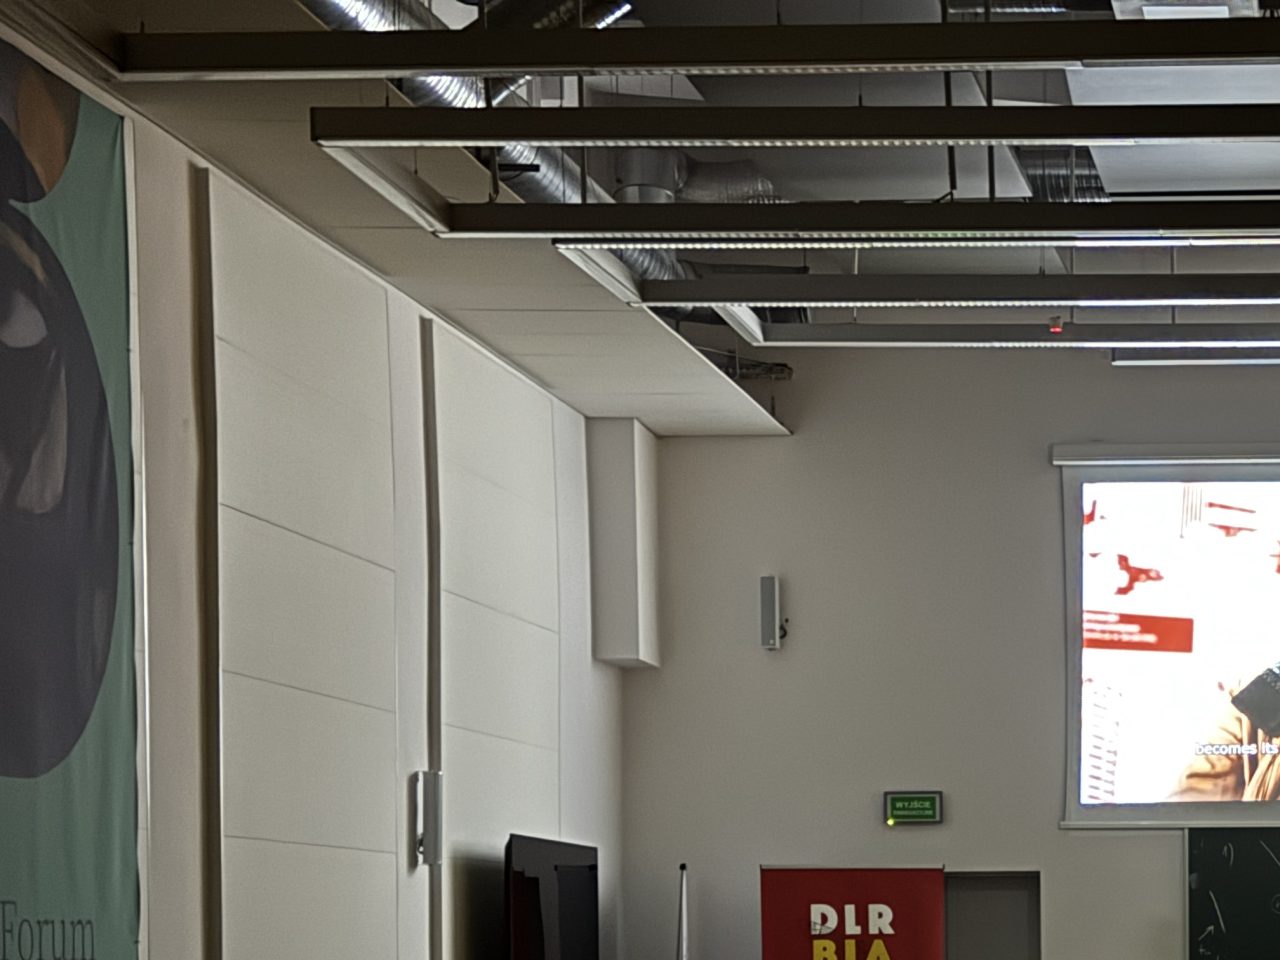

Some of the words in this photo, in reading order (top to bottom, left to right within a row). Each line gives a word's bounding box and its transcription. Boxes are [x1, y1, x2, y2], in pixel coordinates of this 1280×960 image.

[1196, 741, 1257, 755] becomes
[1262, 741, 1280, 754] its
[810, 903, 896, 936] DLR
